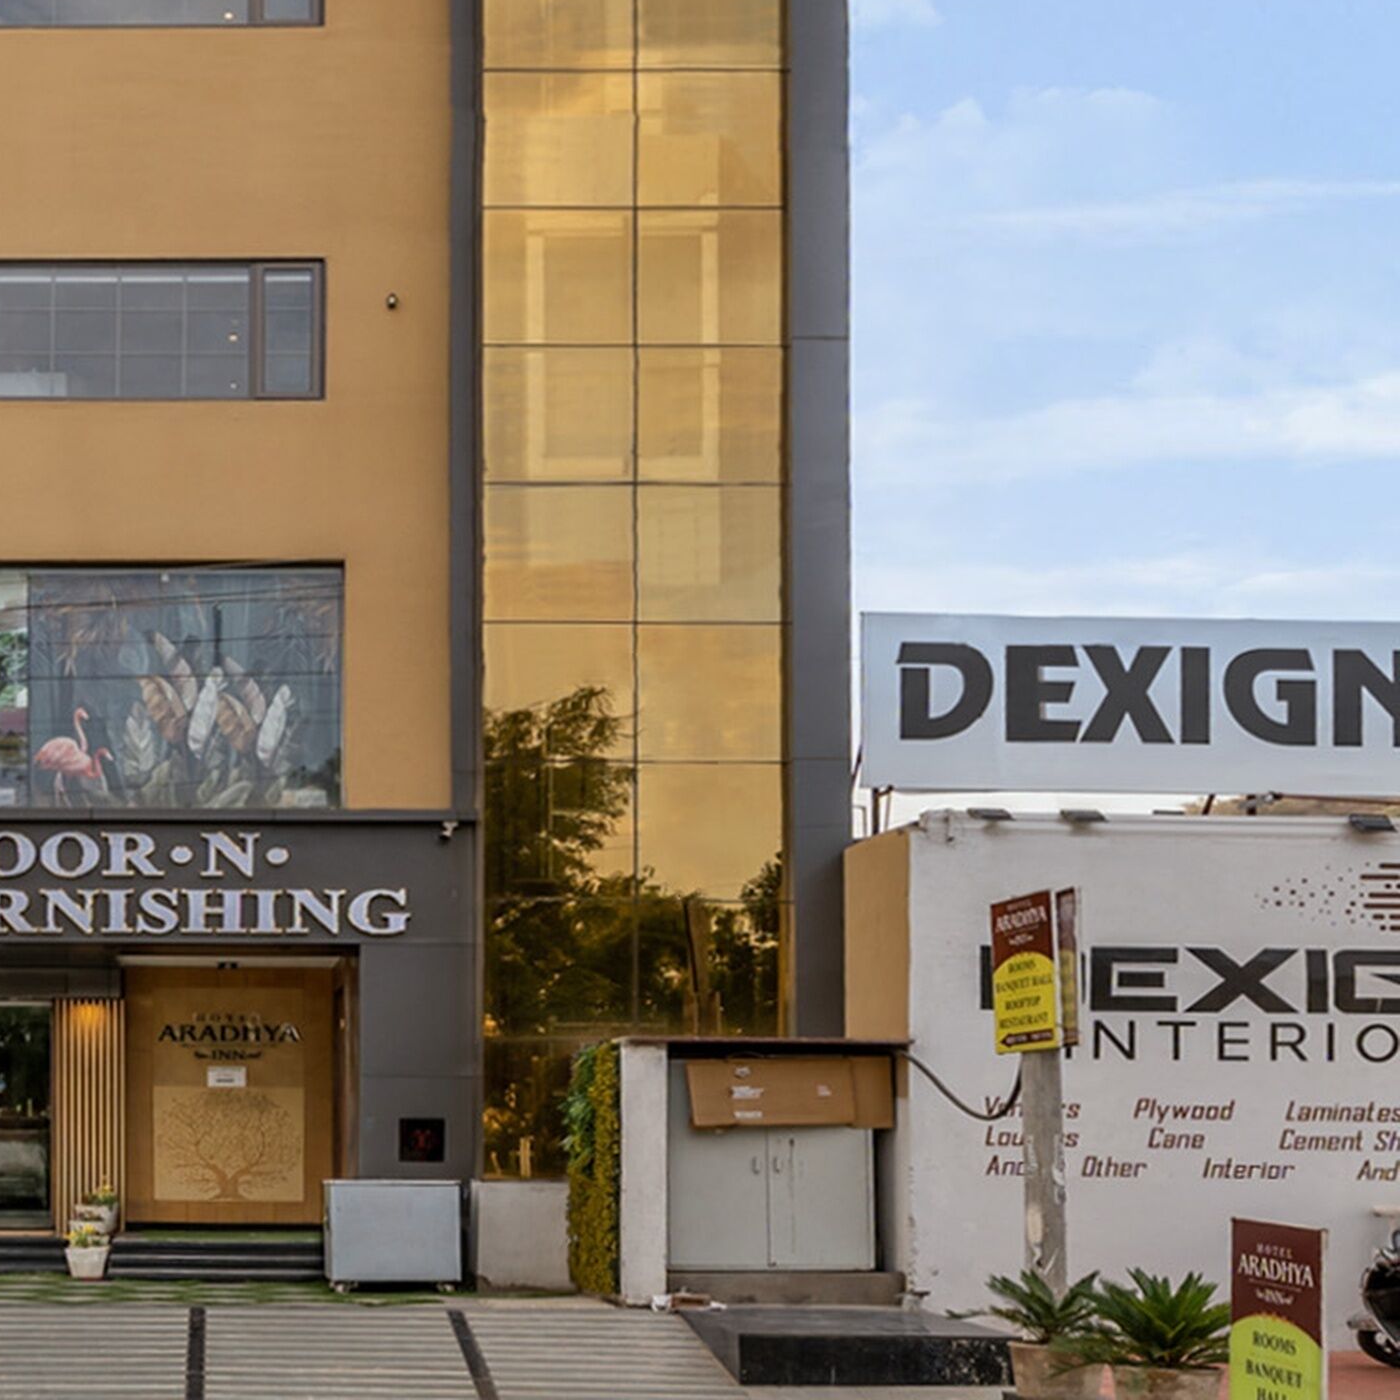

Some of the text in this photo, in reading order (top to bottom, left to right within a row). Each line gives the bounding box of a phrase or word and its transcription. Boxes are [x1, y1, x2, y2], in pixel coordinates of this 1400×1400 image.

[896, 642, 1400, 747] DEXIGN
[158, 1024, 301, 1042] ARADHYA
[211, 1050, 246, 1060] INN
[1133, 1098, 1236, 1123] Plywood
[1285, 1100, 1400, 1122] Laminates
[1148, 1128, 1206, 1150] Cane
[1279, 1128, 1363, 1151] Cement
[1081, 1156, 1148, 1178] Other
[1203, 1159, 1296, 1180] Interior
[1356, 1159, 1400, 1181] And
[1256, 1243, 1293, 1259] HOTEL
[1238, 1253, 1314, 1288] ARADHYA
[1252, 1329, 1297, 1356] ROOMS
[1245, 1358, 1303, 1389] BANQUET
